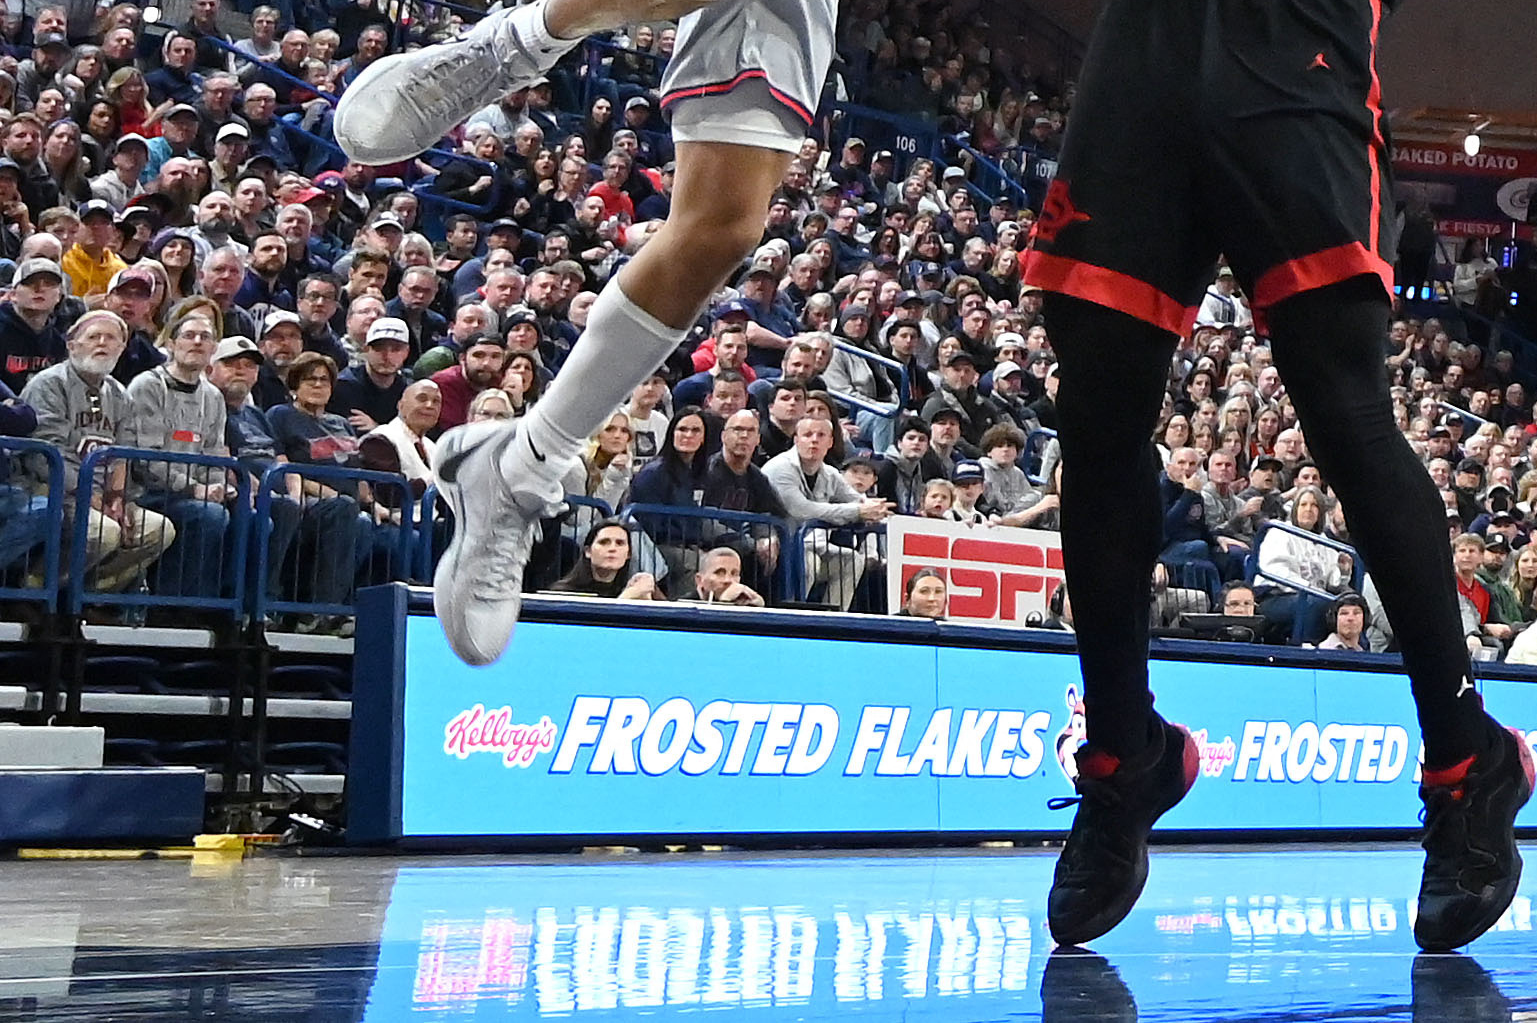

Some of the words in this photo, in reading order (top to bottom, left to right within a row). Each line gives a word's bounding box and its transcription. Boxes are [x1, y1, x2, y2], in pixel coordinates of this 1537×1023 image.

[896, 135, 917, 154] 106
[1452, 150, 1518, 171] POTATO
[902, 533, 1065, 621] ESP
[444, 705, 558, 769] Kellogg's
[550, 694, 839, 776] FROSTED
[844, 705, 1051, 779] FLAKES
[1231, 720, 1409, 783] FROSTED
